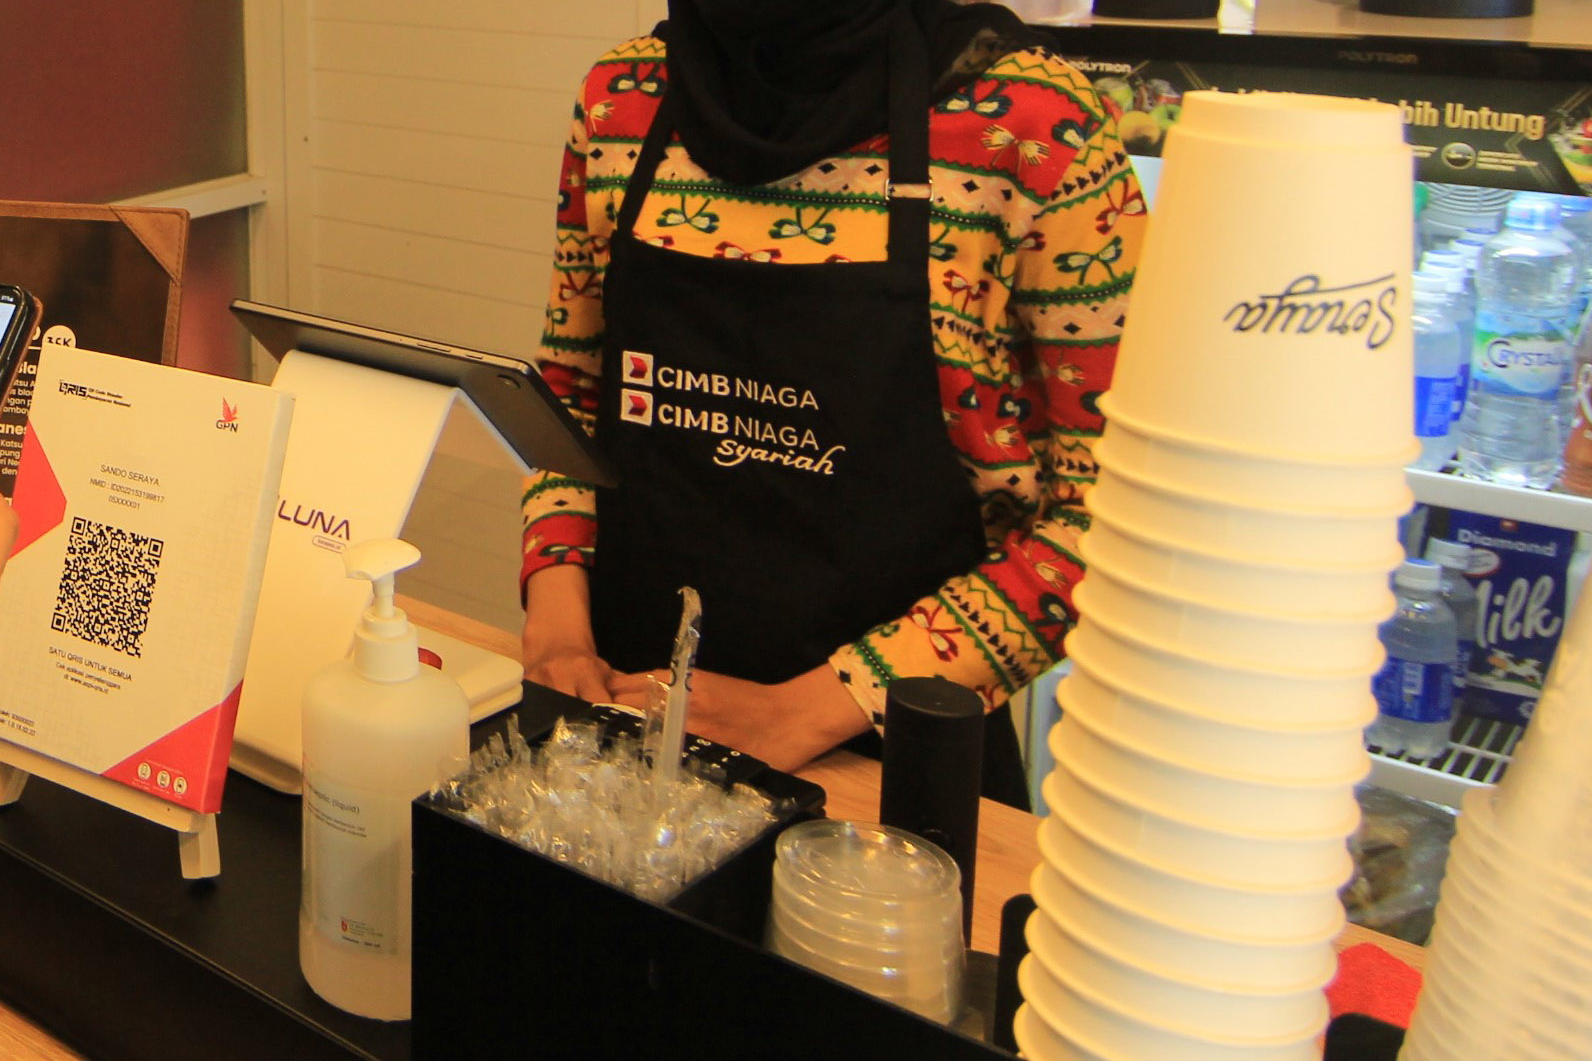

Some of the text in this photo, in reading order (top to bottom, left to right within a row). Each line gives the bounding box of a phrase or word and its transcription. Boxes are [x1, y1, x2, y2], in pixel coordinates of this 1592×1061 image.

[1445, 102, 1546, 141] Untung
[1223, 272, 1397, 350] Seraya
[657, 366, 819, 411] CIMB NIAGA
[216, 419, 239, 433] GPN
[658, 403, 819, 451] CIMB NIAGA
[100, 464, 160, 487] SANDO SERAYA
[277, 499, 351, 541] LUNA
[1457, 527, 1557, 557] Diamond
[49, 646, 132, 682] SATU QRIS UNTUK SEMUA
